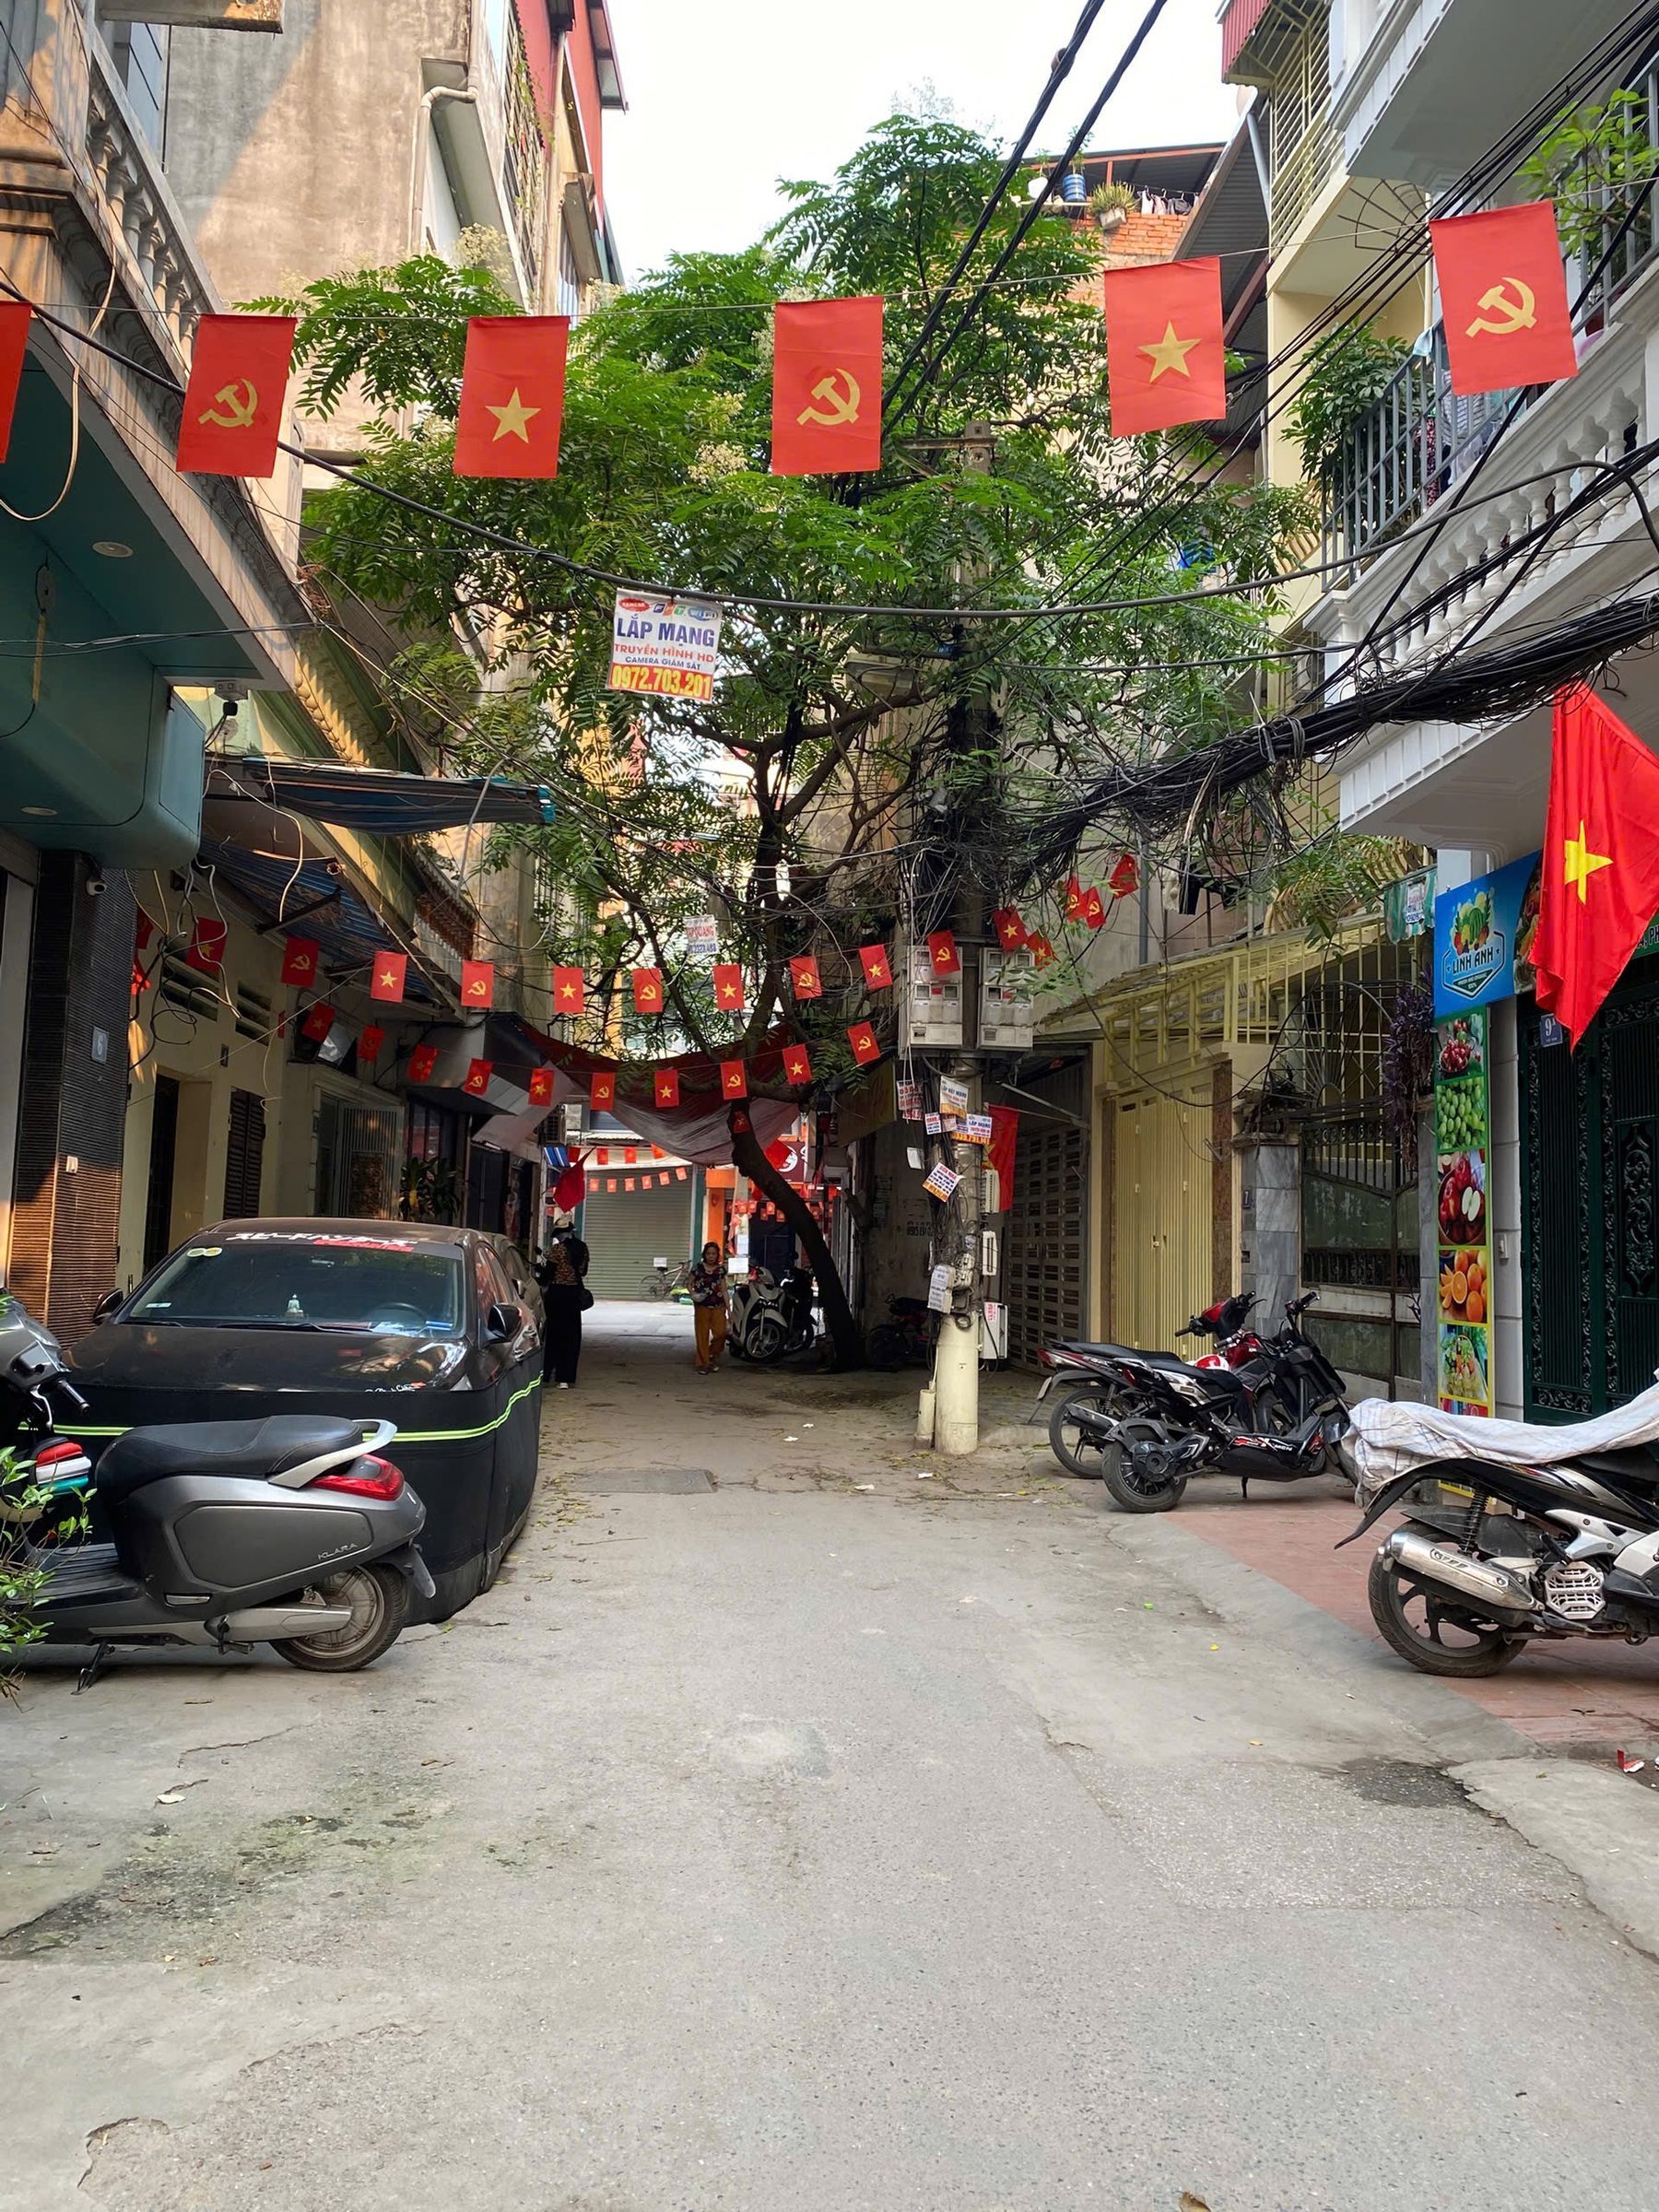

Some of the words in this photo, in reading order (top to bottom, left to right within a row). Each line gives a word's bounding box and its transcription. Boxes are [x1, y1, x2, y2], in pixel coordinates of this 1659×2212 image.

[617, 614, 653, 639] LẮP
[658, 623, 714, 647] MẠNG
[615, 643, 658, 655] TRUYỀN
[664, 647, 693, 659] HÌNH
[698, 653, 714, 663] HD
[625, 656, 659, 665] CAMERA
[612, 665, 711, 699] 0972.703.201
[1453, 955, 1472, 974] LINH
[1475, 947, 1493, 968] ANH
[318, 1543, 358, 1559] KLARA
